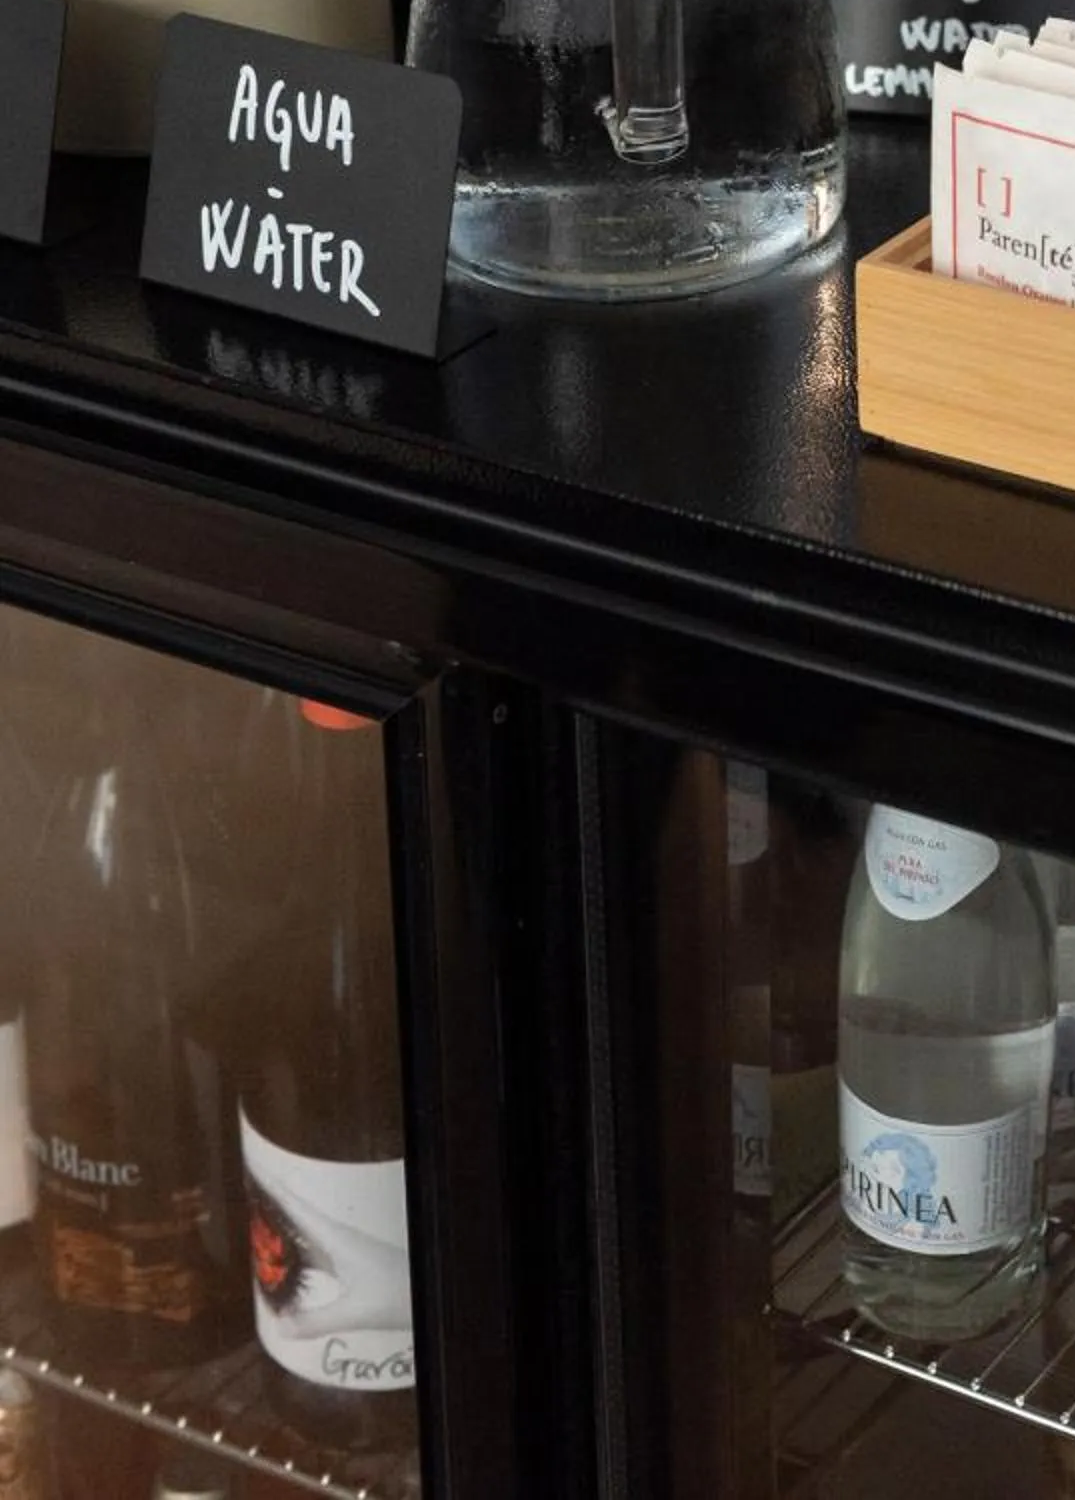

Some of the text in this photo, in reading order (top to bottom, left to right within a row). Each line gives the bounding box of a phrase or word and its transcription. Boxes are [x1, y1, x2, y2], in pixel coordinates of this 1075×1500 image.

[228, 64, 354, 171] AGUA
[201, 198, 381, 316] WATER
[51, 1136, 144, 1187] Blanc
